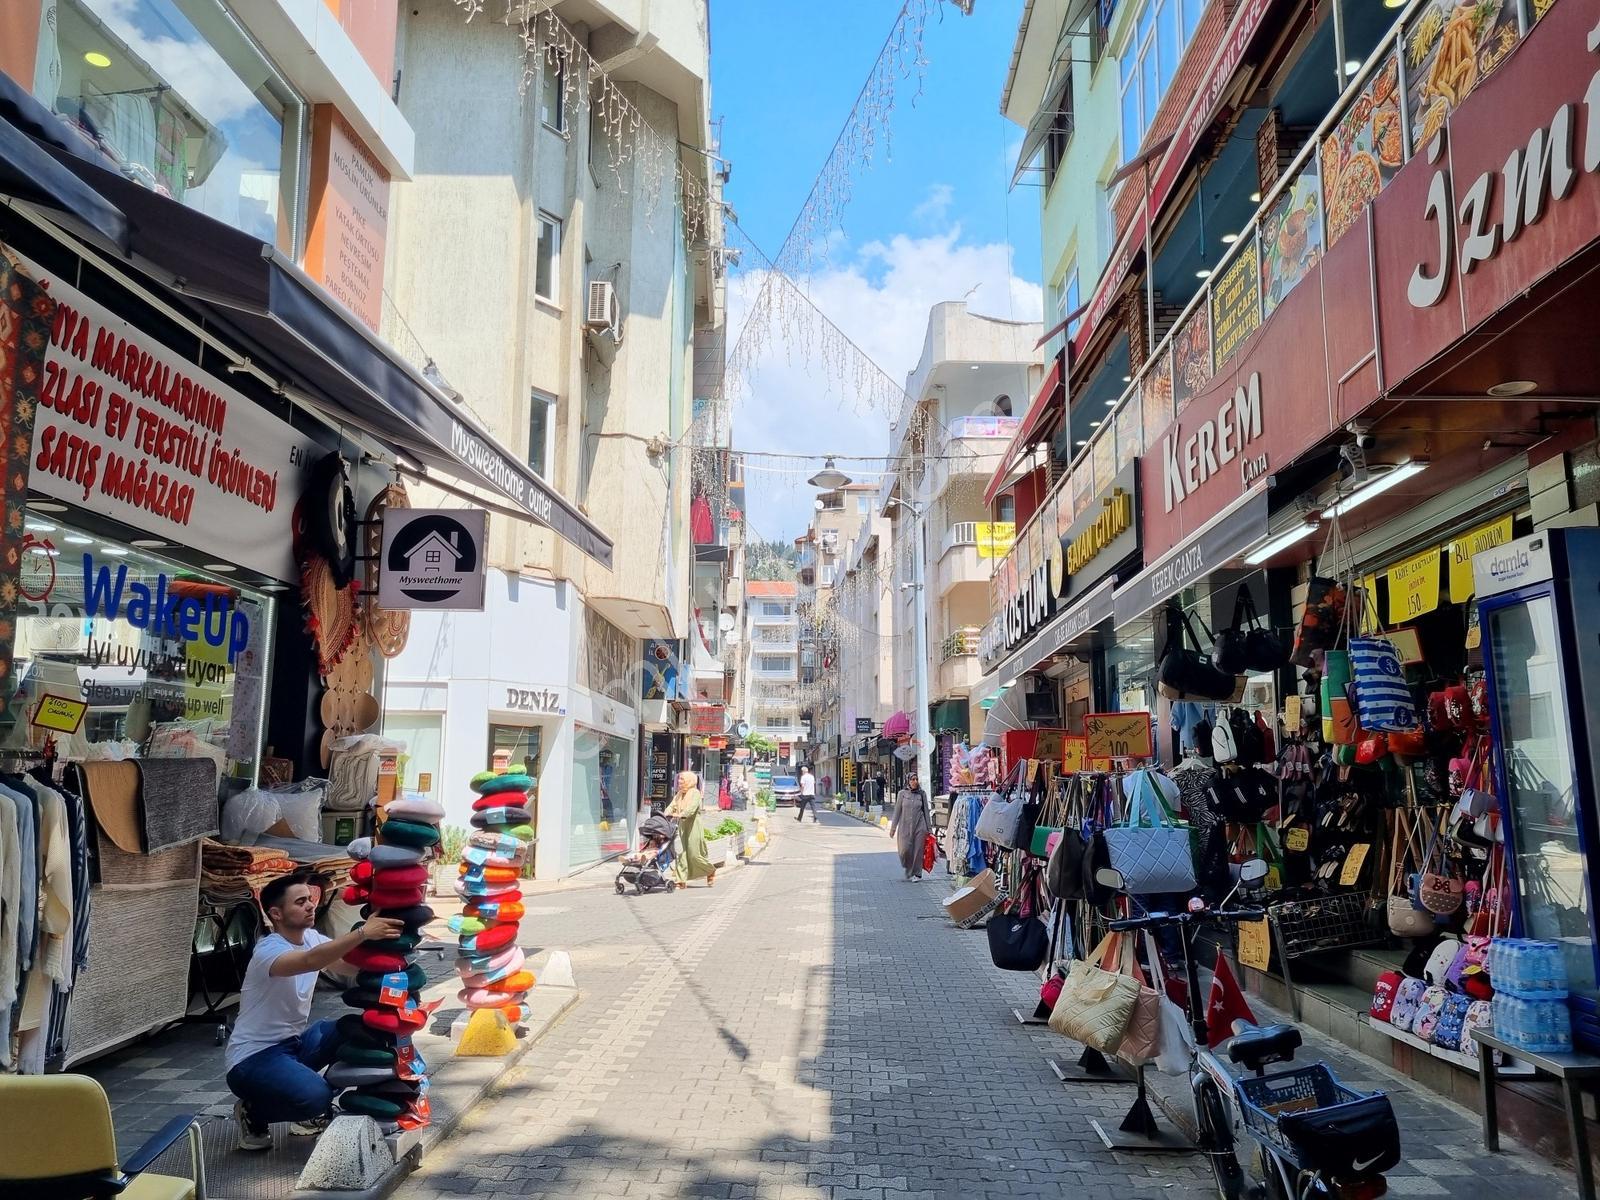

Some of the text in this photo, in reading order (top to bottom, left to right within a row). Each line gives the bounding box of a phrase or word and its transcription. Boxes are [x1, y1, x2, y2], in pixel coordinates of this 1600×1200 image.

[351, 153, 374, 188] PAMUK
[335, 206, 355, 236] YATAK
[325, 275, 347, 303] PAREO
[340, 271, 367, 305] BORNOZ
[91, 325, 228, 437] MARKALARININ
[105, 392, 134, 442] EV
[134, 407, 208, 479] TEKSTİLİ
[208, 438, 279, 514] ÜRÜNLERİ
[1163, 371, 1263, 514] KEREM
[36, 424, 195, 526] SATIŞ MAĞAZASI
[451, 418, 552, 523] Mysweethome outlet
[1242, 452, 1269, 493] ÇANTA
[399, 575, 463, 585] Mysweethome
[1151, 544, 1204, 597] KEREM ÇANTA
[1491, 548, 1529, 577] damla
[83, 552, 249, 665] WakeUp
[1407, 592, 1422, 616] 150
[187, 658, 227, 688] uyan
[82, 678, 121, 701] Sleep
[187, 697, 202, 716] up
[203, 699, 224, 715] well
[506, 688, 560, 713] DENİZ
